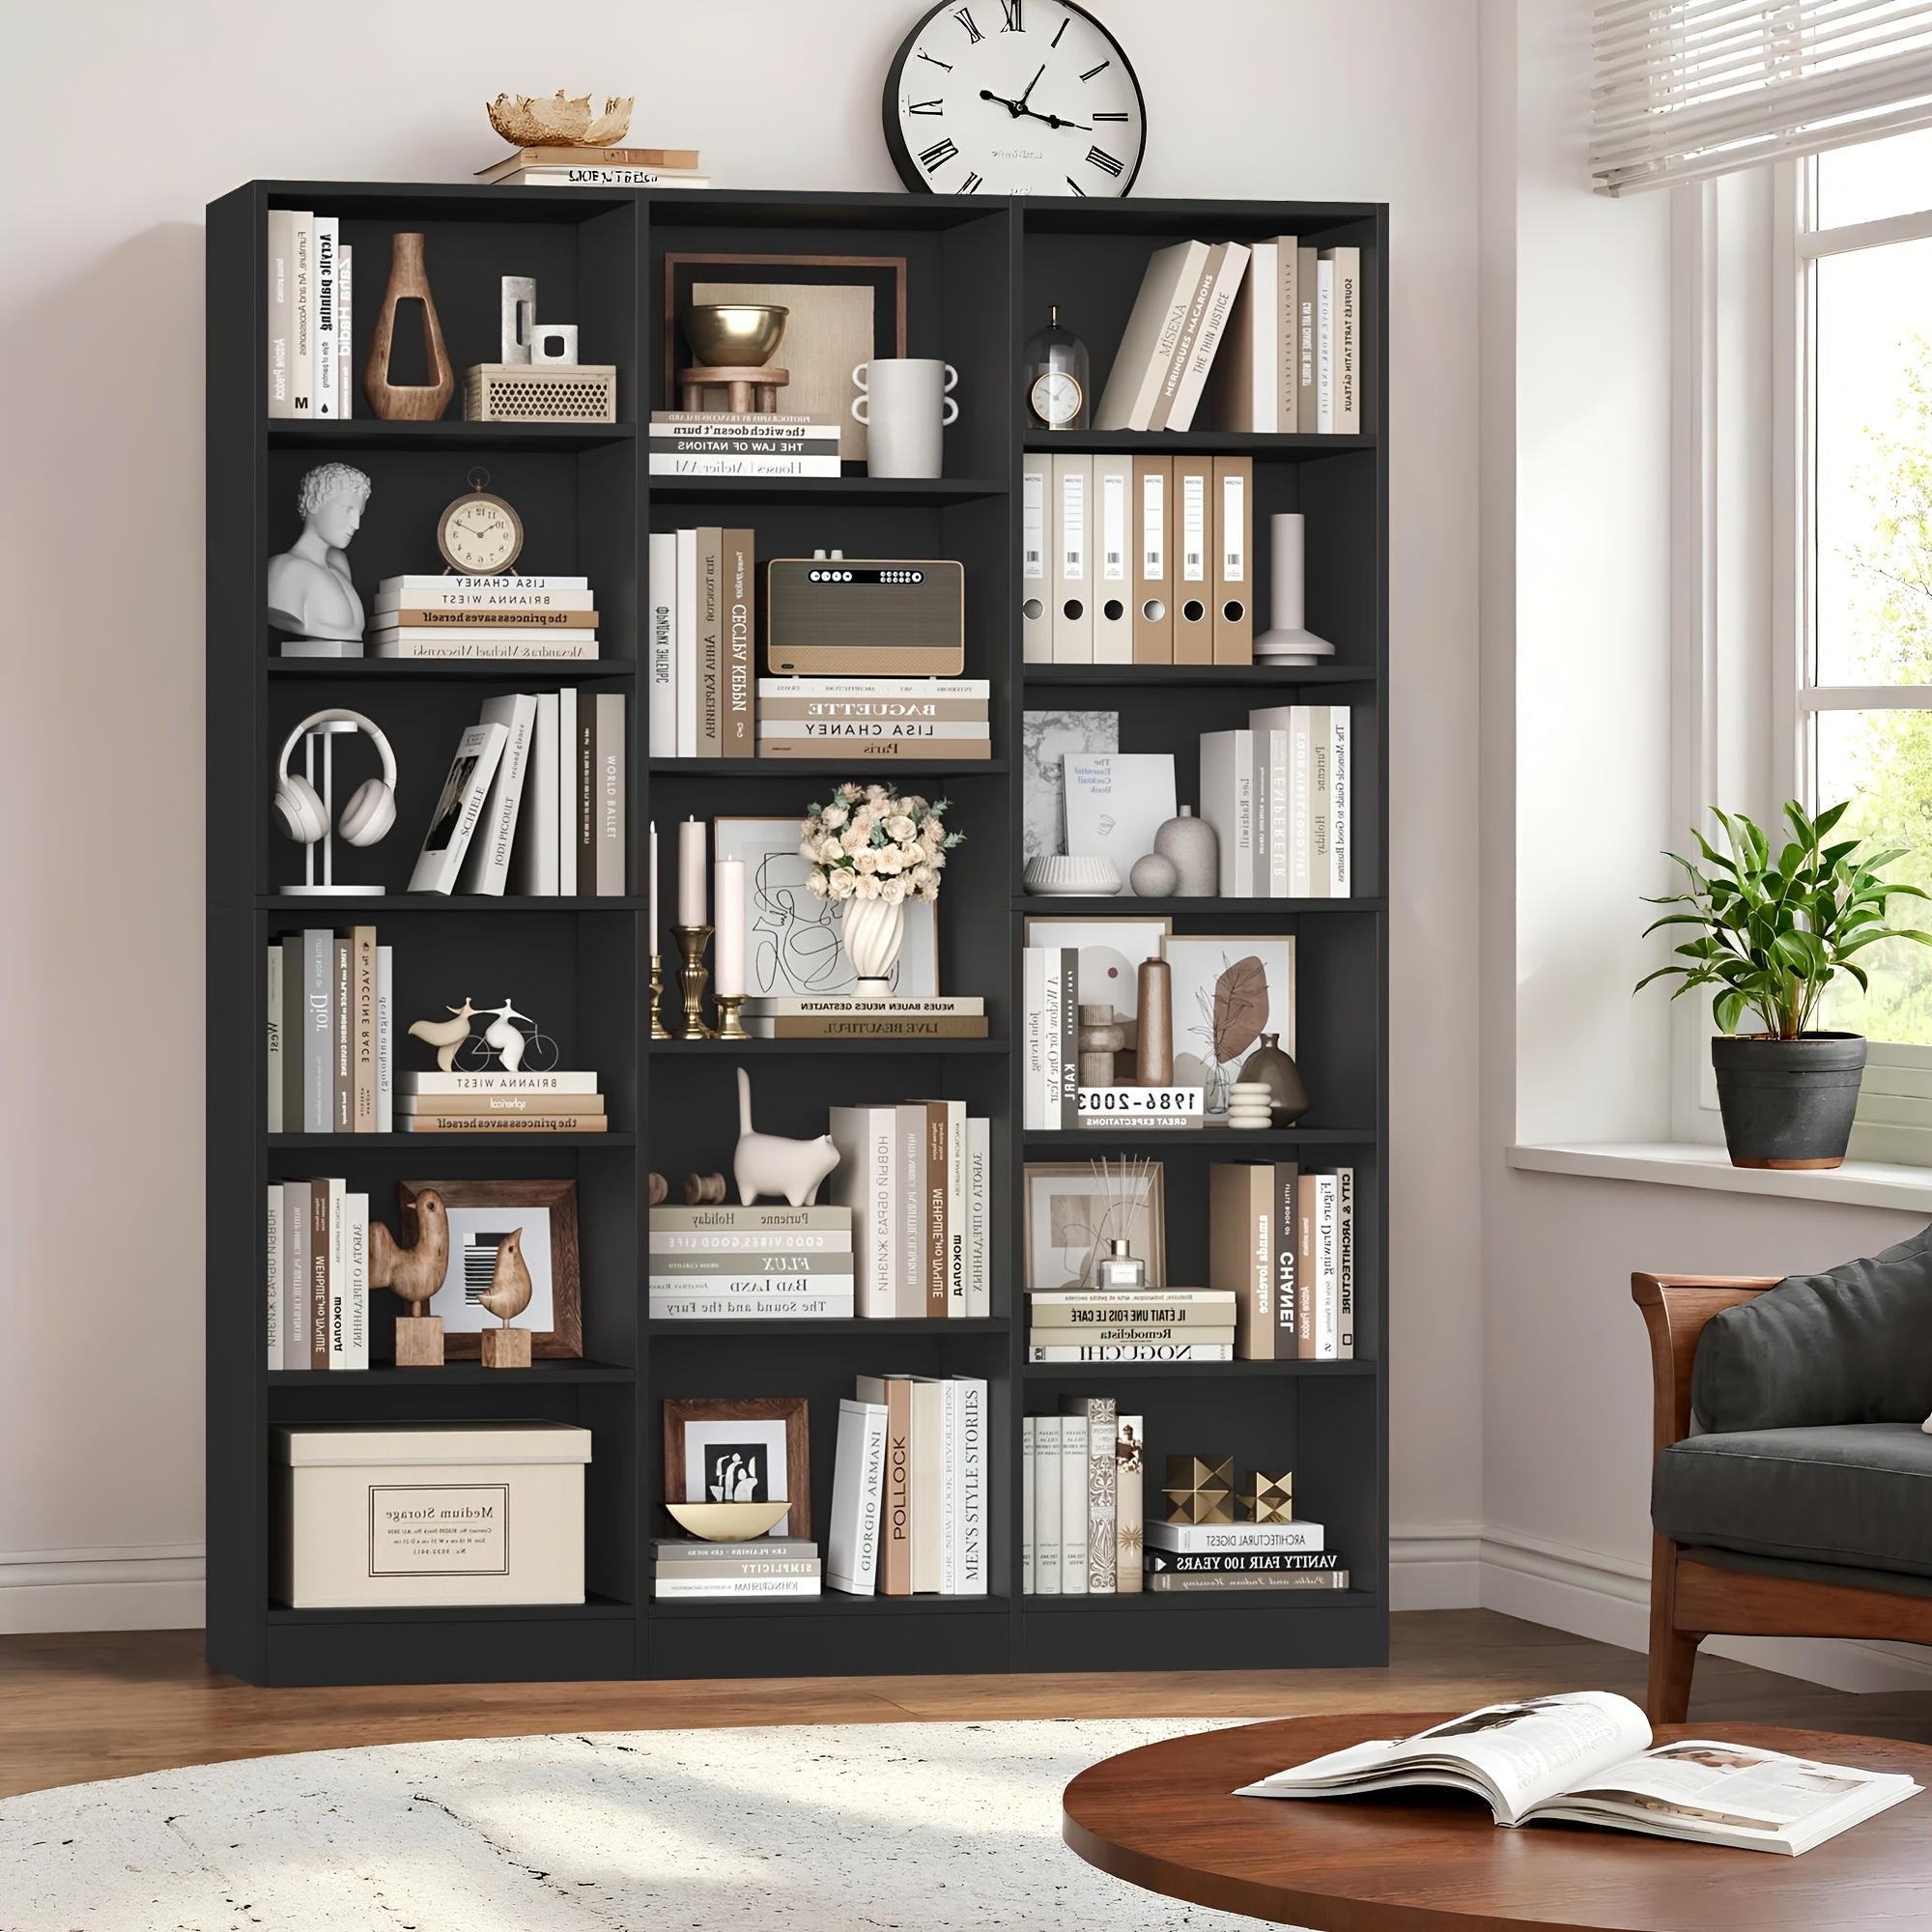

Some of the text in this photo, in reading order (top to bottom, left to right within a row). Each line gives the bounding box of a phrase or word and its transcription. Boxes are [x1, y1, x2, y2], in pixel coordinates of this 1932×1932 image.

[1165, 273, 1213, 398] MERINGUES MACARONS
[1193, 292, 1229, 374] THE THIN JUSTICE
[296, 397, 308, 409] M
[511, 724, 525, 780] second glance
[461, 787, 485, 837] SCHIELE
[498, 796, 514, 840] PICOULT
[606, 755, 617, 839] WORLD BALLET
[862, 1431, 881, 1572] GIORGIO ARMANI
[894, 1436, 906, 1540] POLLOCK
[965, 1390, 979, 1580] MEN'S STYLE STORIES
